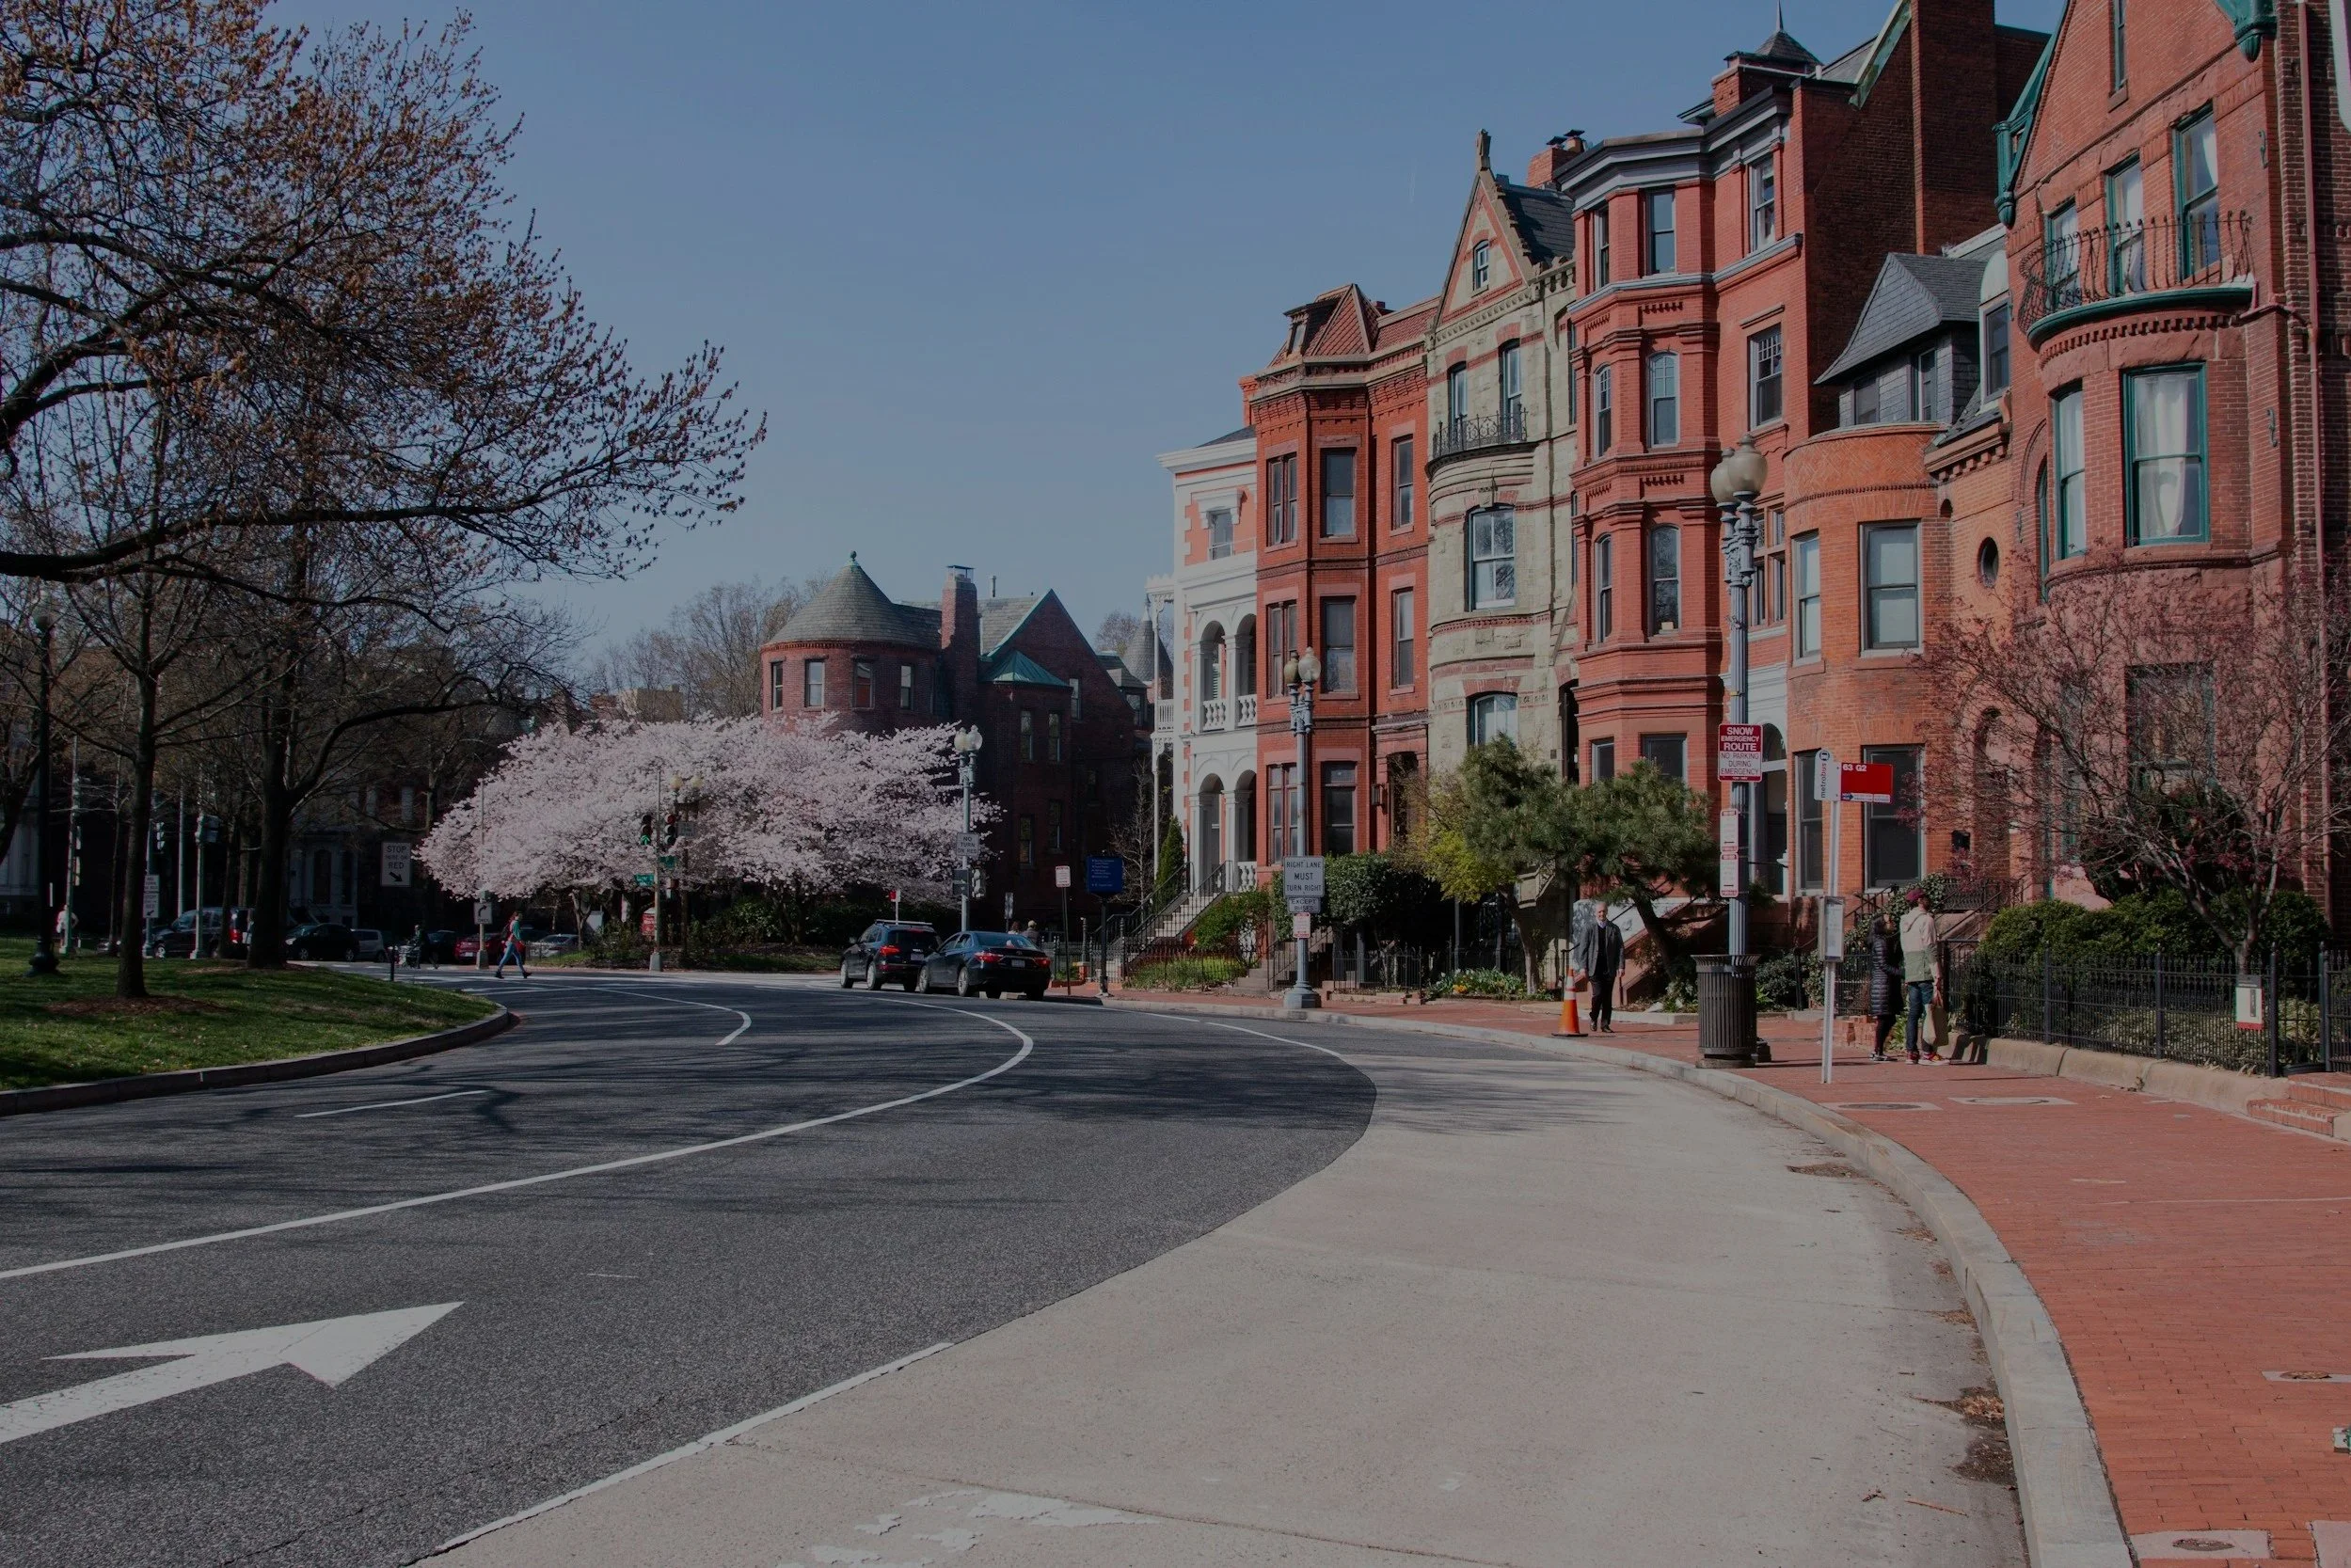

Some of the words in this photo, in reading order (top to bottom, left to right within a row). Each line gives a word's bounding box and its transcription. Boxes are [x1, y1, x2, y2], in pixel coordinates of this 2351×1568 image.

[1726, 726, 1755, 736] SNOW
[1724, 742, 1757, 752] ROUTE
[1842, 763, 1853, 771] 63
[1854, 764, 1867, 772] G2
[1294, 872, 1313, 880] MUST
